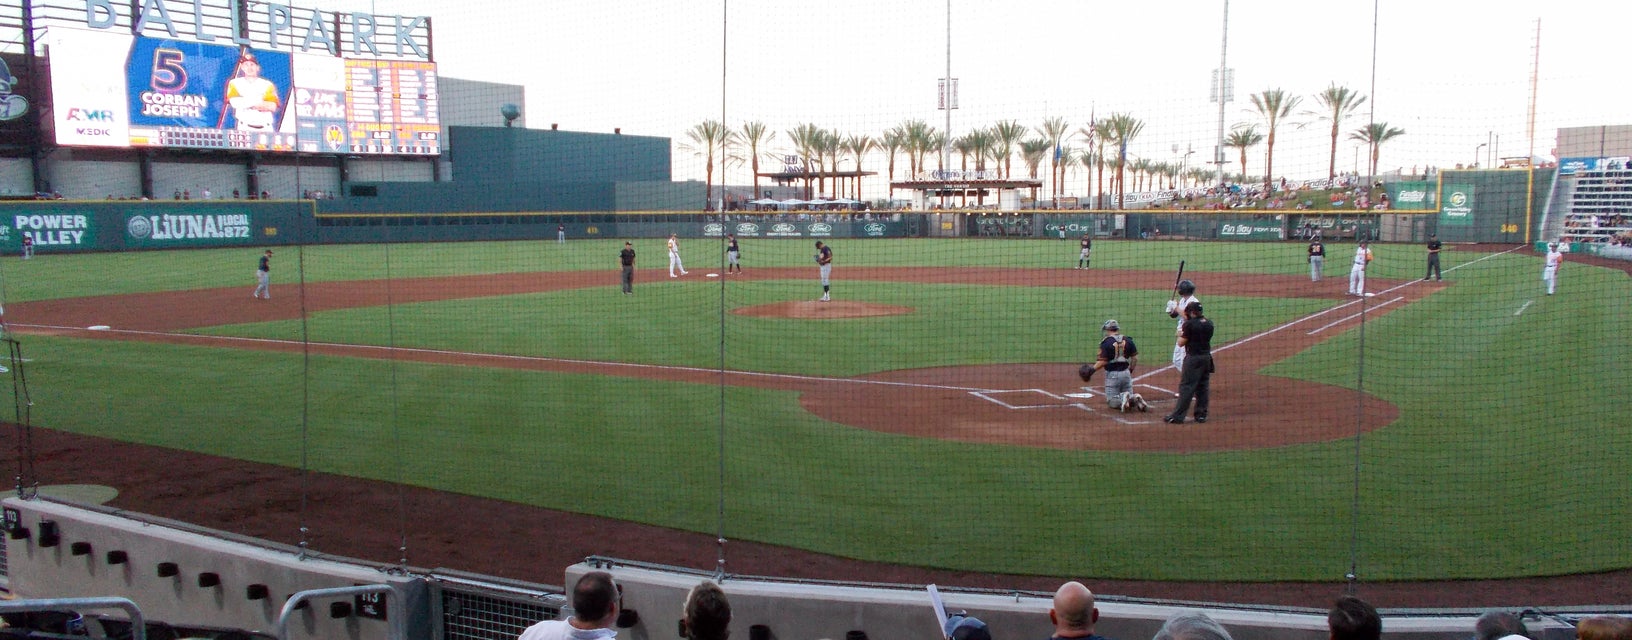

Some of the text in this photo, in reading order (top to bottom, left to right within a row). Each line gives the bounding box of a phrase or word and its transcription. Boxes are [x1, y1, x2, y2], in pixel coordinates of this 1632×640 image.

[87, 0, 430, 58] BALLPARK
[152, 48, 187, 92] 5
[141, 92, 206, 108] CORBAN
[142, 104, 200, 118] JOSEPH
[16, 215, 87, 229] POWER
[223, 214, 249, 224] LOCAL
[23, 231, 84, 245] ALLEY
[223, 226, 249, 238] 872
